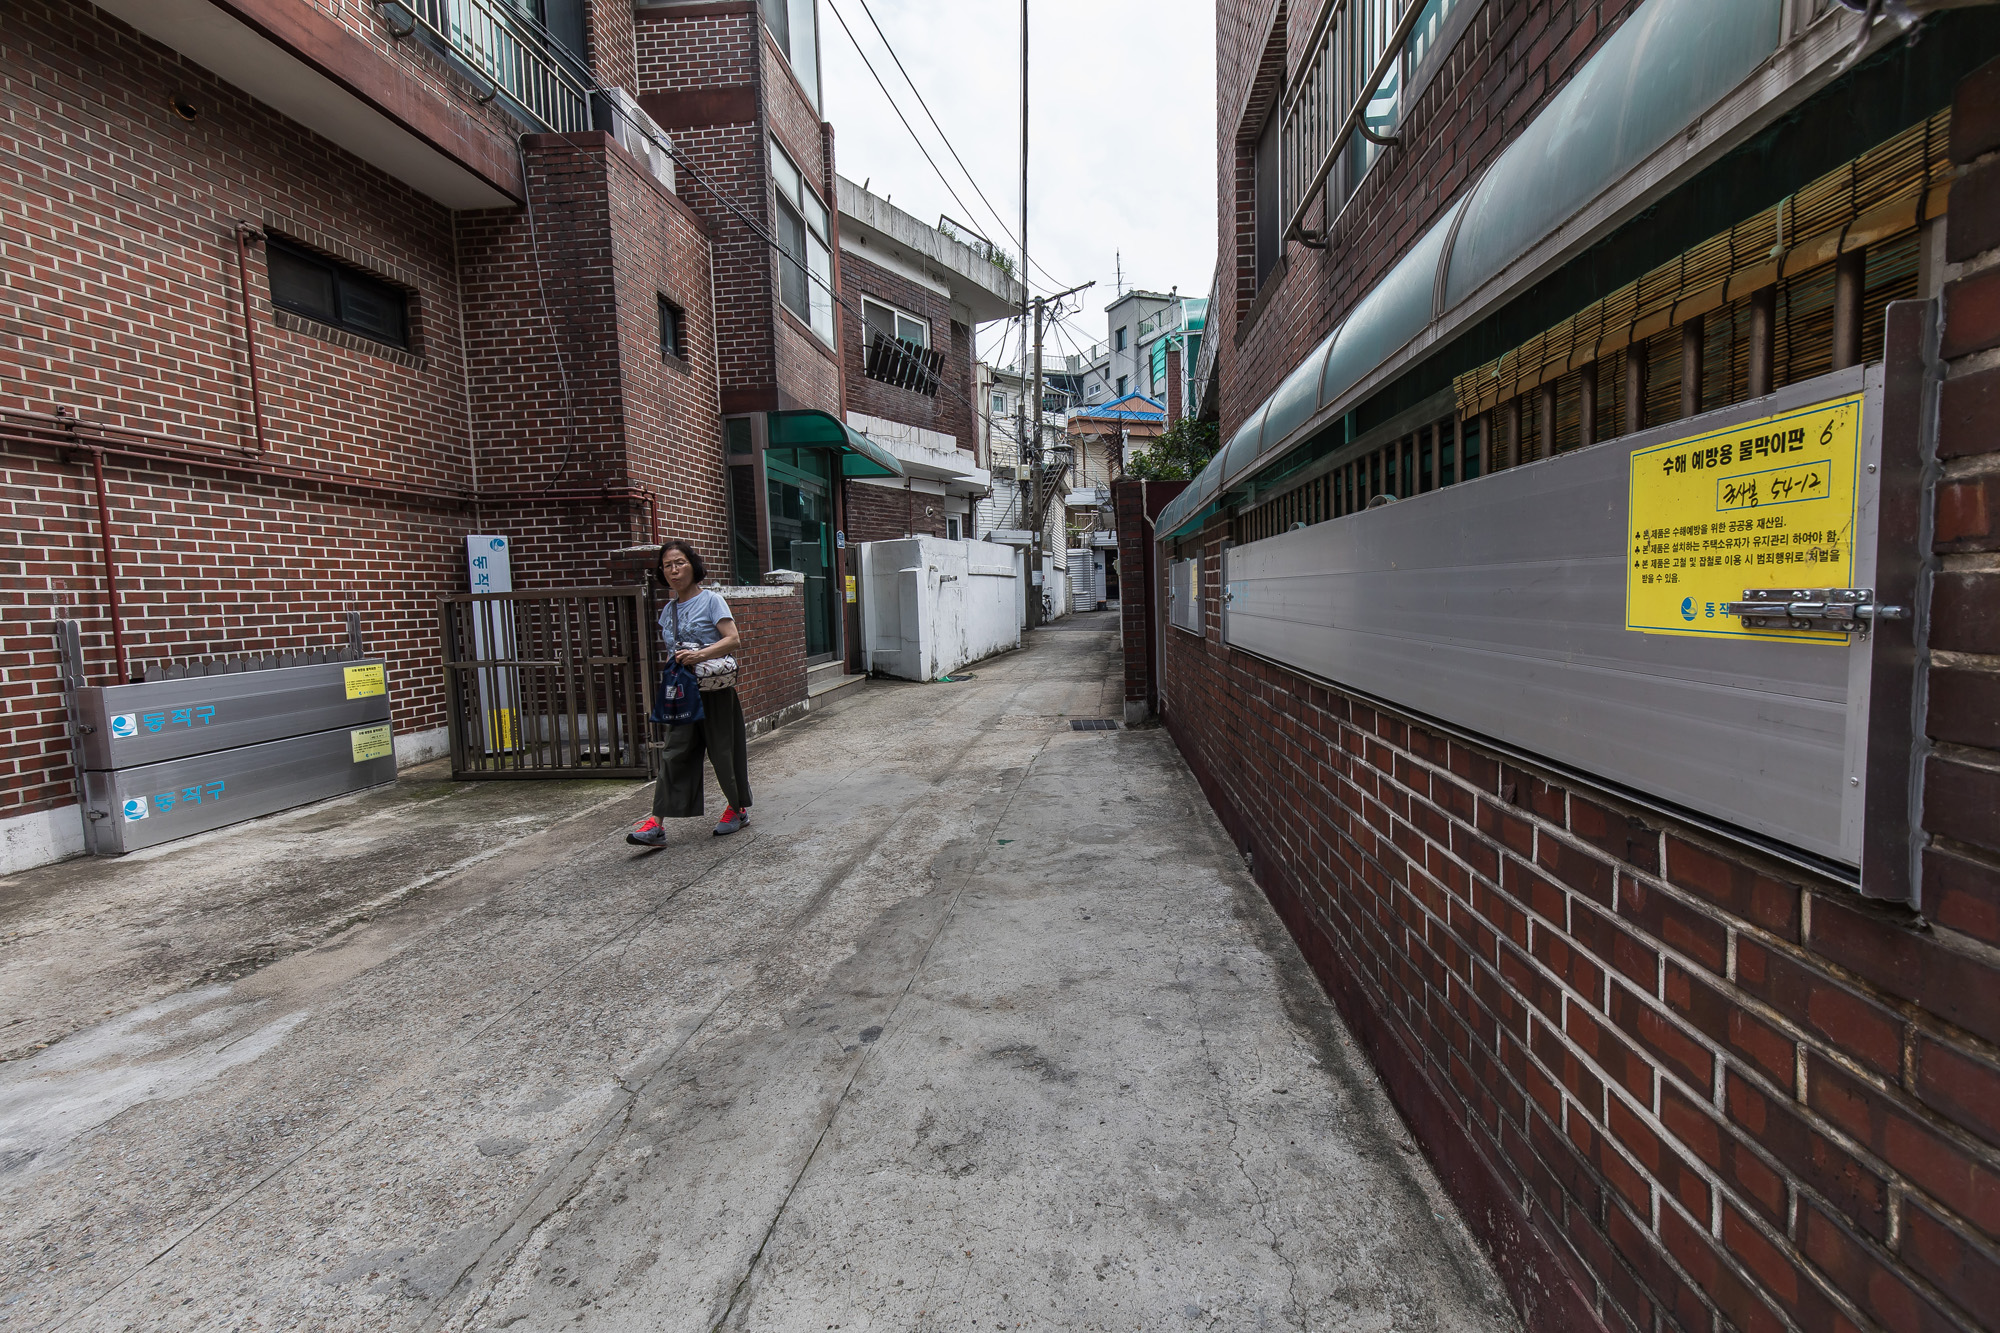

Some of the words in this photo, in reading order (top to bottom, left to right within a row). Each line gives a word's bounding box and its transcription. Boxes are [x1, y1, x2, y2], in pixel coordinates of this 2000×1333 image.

[1662, 454, 1687, 476] 수해
[1691, 443, 1733, 470] 예방용
[1739, 427, 1806, 462] 물막이판
[1770, 472, 1822, 500] 54-12
[1651, 528, 1670, 539] 제품은
[1672, 524, 1708, 537] 수해예방을
[1711, 522, 1726, 534] 위한
[1728, 519, 1753, 532] 공공용
[1756, 516, 1787, 529] 재산임.
[1642, 545, 1649, 554] 본
[1650, 543, 1670, 554] 제품은
[1672, 541, 1700, 553] 설치하는
[1702, 537, 1750, 551] 주택소유자가
[1753, 533, 1789, 547] 유지관리
[1792, 531, 1822, 545] 하여야
[1826, 530, 1840, 543] 함.
[1642, 560, 1648, 569] 본
[1650, 558, 1670, 569] 제품은
[1672, 557, 1687, 568] 고철
[1689, 557, 1697, 568] 및
[1699, 556, 1722, 567] 잡철로
[1724, 554, 1742, 566] 이용
[1744, 553, 1753, 565] 시
[1757, 551, 1804, 565] 범죄행위로
[1808, 549, 1840, 562] 처벌을
[472, 556, 490, 593] 동작
[1642, 573, 1654, 584] 받을
[1656, 574, 1663, 583] 수
[1664, 573, 1680, 584] 있음.
[1704, 602, 1741, 619] 동작
[143, 705, 216, 733] 동작구
[154, 780, 225, 813] 동작구
